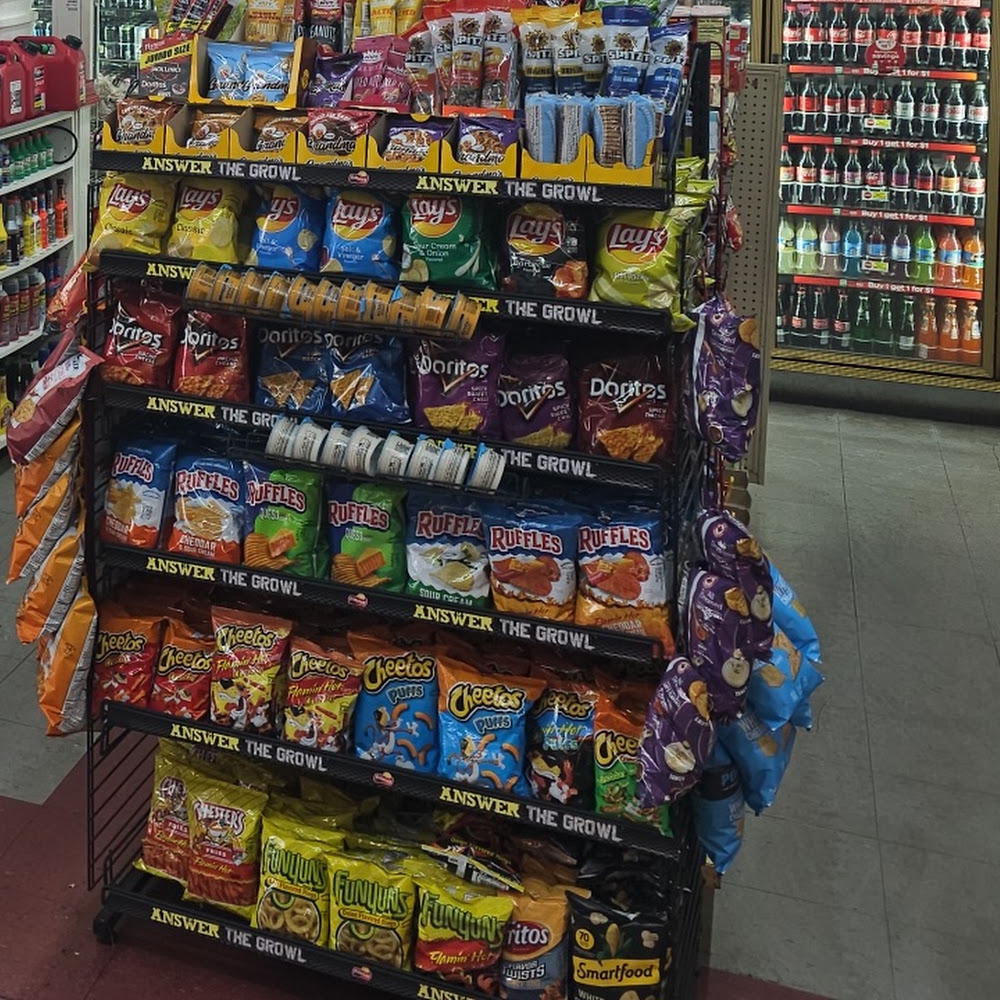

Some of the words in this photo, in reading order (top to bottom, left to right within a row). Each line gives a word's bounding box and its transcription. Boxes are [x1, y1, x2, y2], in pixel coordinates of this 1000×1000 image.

[173, 42, 192, 58] SIZE
[862, 139, 878, 147] Buy
[142, 156, 212, 176] ANSWER
[217, 161, 245, 178] THE
[250, 162, 302, 182] GROWL
[108, 184, 150, 213] Lay's
[179, 187, 222, 211] Lay's
[416, 175, 498, 196] ANSWER
[504, 179, 537, 198] THE
[542, 183, 603, 202] GROWL
[332, 200, 384, 232] Lay's
[508, 217, 563, 247] Lay's
[609, 222, 668, 254] Lay's
[426, 249, 449, 258] Onion
[431, 243, 457, 251] Cream
[506, 300, 537, 317] THE
[542, 304, 603, 325] GROWL
[259, 327, 322, 345] Doritos
[414, 353, 489, 379] Doritos
[500, 378, 567, 408] Doritos
[590, 377, 668, 400] Doritos
[146, 397, 216, 420] ANSWER
[221, 406, 248, 425] THE
[112, 452, 155, 483] RUFFLES
[536, 455, 597, 480] GROWL
[175, 470, 240, 502] RUFFLES
[247, 480, 306, 513] RUFFLES
[329, 501, 390, 529] RUFFLES
[180, 534, 217, 551] CHEDDAR
[489, 526, 563, 555] RUFFLES
[577, 525, 651, 554] RUFFLES
[146, 556, 216, 581] ANSWER
[221, 568, 248, 588] THE
[251, 573, 302, 597] GROWL
[216, 624, 277, 655] Cheetos
[413, 604, 494, 632] ANSWER
[499, 619, 531, 640] THE
[535, 625, 596, 651] GROWL
[158, 646, 213, 675] Cheetos
[289, 651, 351, 681] Cheetos
[363, 653, 437, 694] Cheetos
[388, 684, 424, 704] PUFFS
[448, 682, 527, 721] Cheetos
[474, 714, 512, 733] PUFFS
[170, 723, 240, 751] ANSWER
[245, 740, 272, 760] THE
[276, 747, 328, 772] GROWL
[439, 786, 520, 818] ANSWER
[526, 804, 557, 828] THE
[562, 814, 623, 843] GROWL
[263, 841, 328, 892] FUNYUNS
[334, 870, 411, 919] FUNYUNS
[150, 907, 220, 939] ANSWER
[225, 927, 252, 948] THE
[255, 935, 307, 963] GROWL
[420, 893, 504, 948] FUNYUNS
[578, 931, 589, 943] 70
[577, 962, 653, 981] Smartfood
